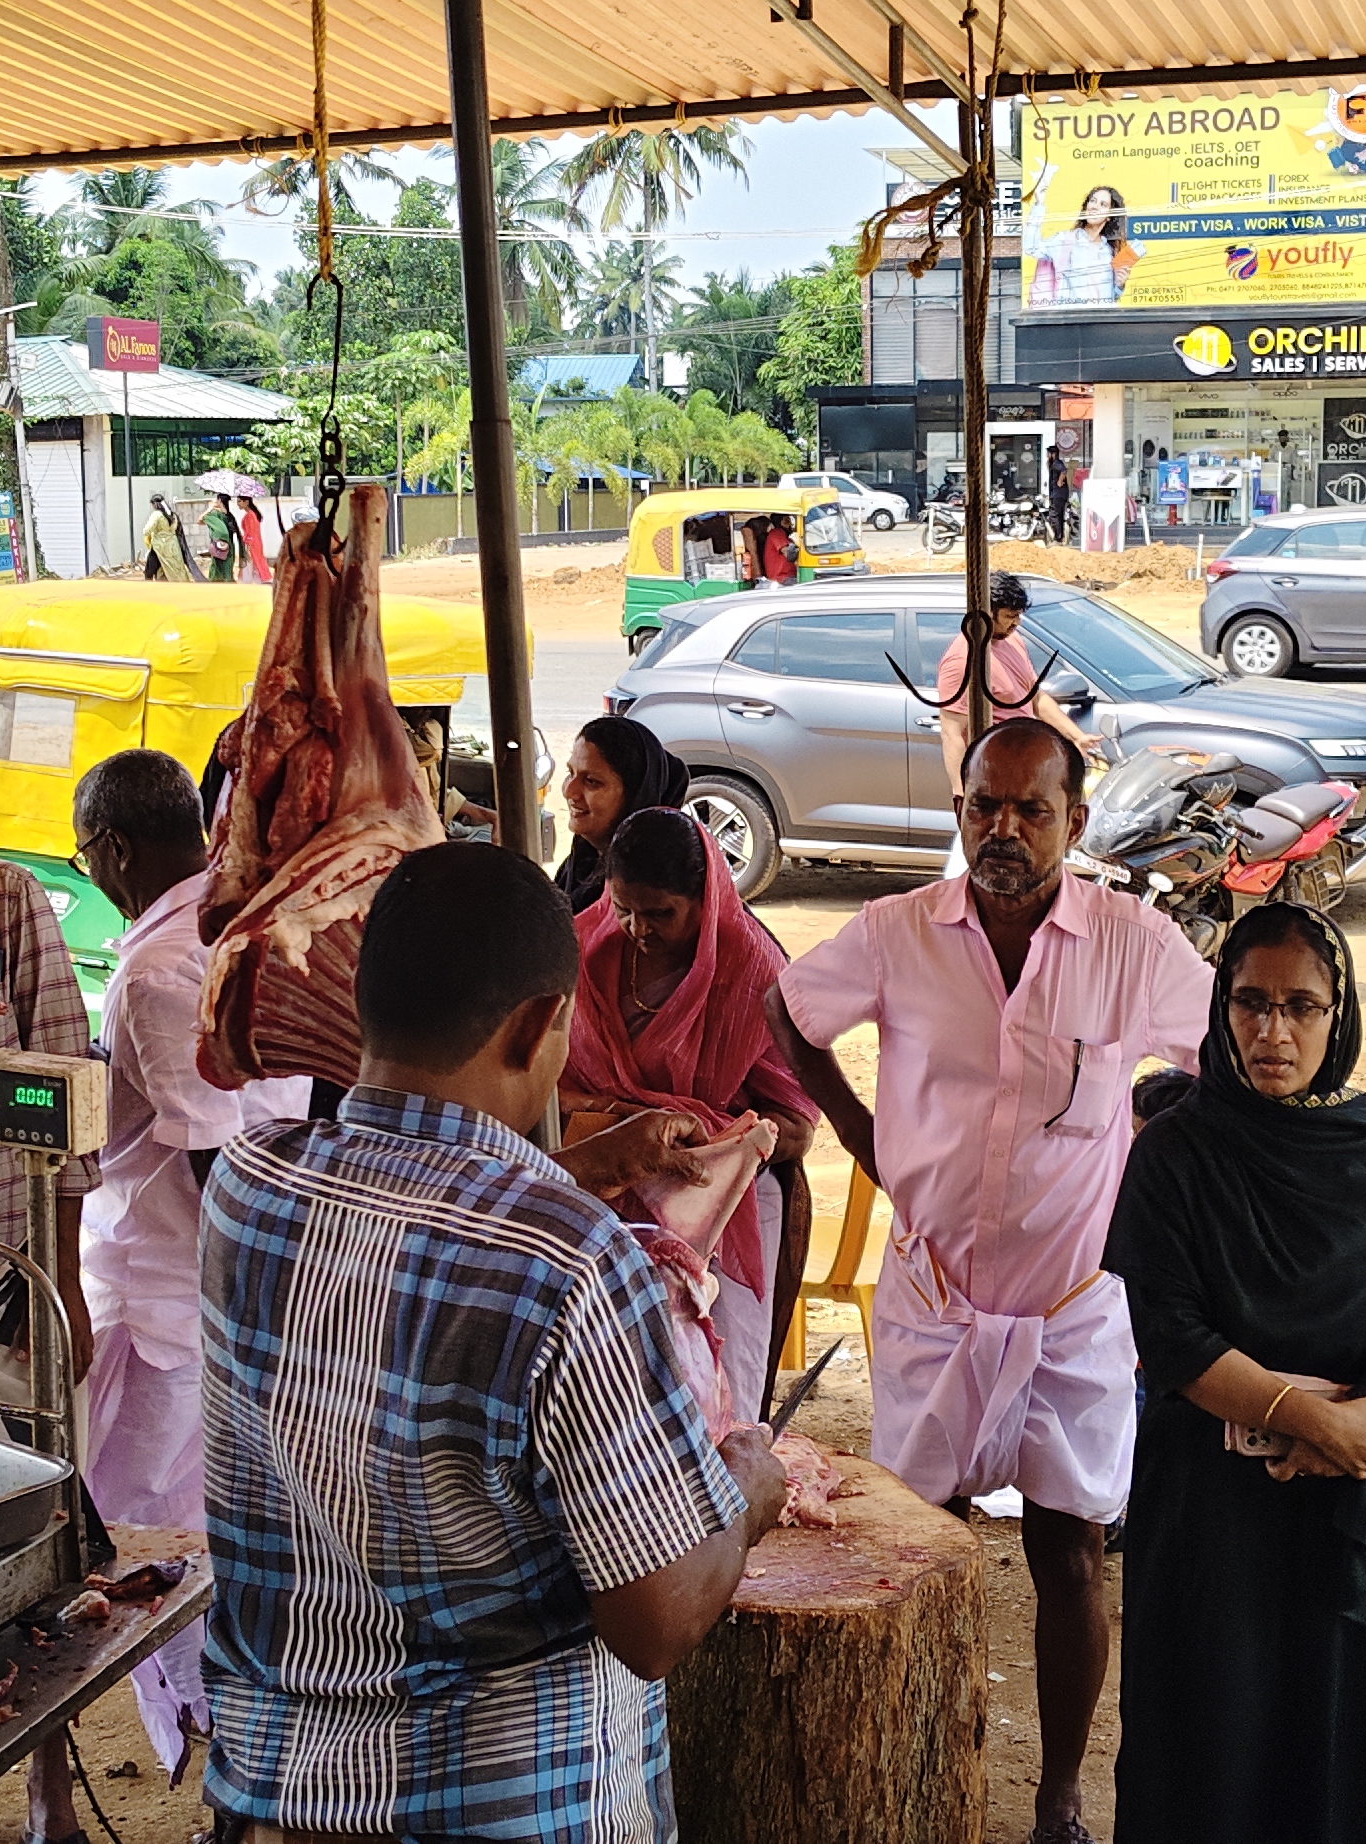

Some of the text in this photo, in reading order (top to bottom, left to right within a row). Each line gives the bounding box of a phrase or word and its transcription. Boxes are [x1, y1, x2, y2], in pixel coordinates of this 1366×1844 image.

[1032, 106, 1280, 141] STUDY ABROAD
[1072, 141, 1261, 159] German Language IELTS OET
[1184, 153, 1260, 168] coaching
[1181, 178, 1262, 191] FLIGHT TICKETS
[1278, 174, 1309, 183] FOREX
[1181, 193, 1207, 204] TOUR
[1278, 195, 1335, 205] INVESTMENT
[1132, 220, 1199, 234] STUDENT
[1201, 219, 1233, 232] VISA
[1244, 218, 1288, 231] WORK
[1292, 216, 1325, 229] VISA
[1267, 241, 1354, 271] youfly
[1251, 356, 1305, 373] SALES
